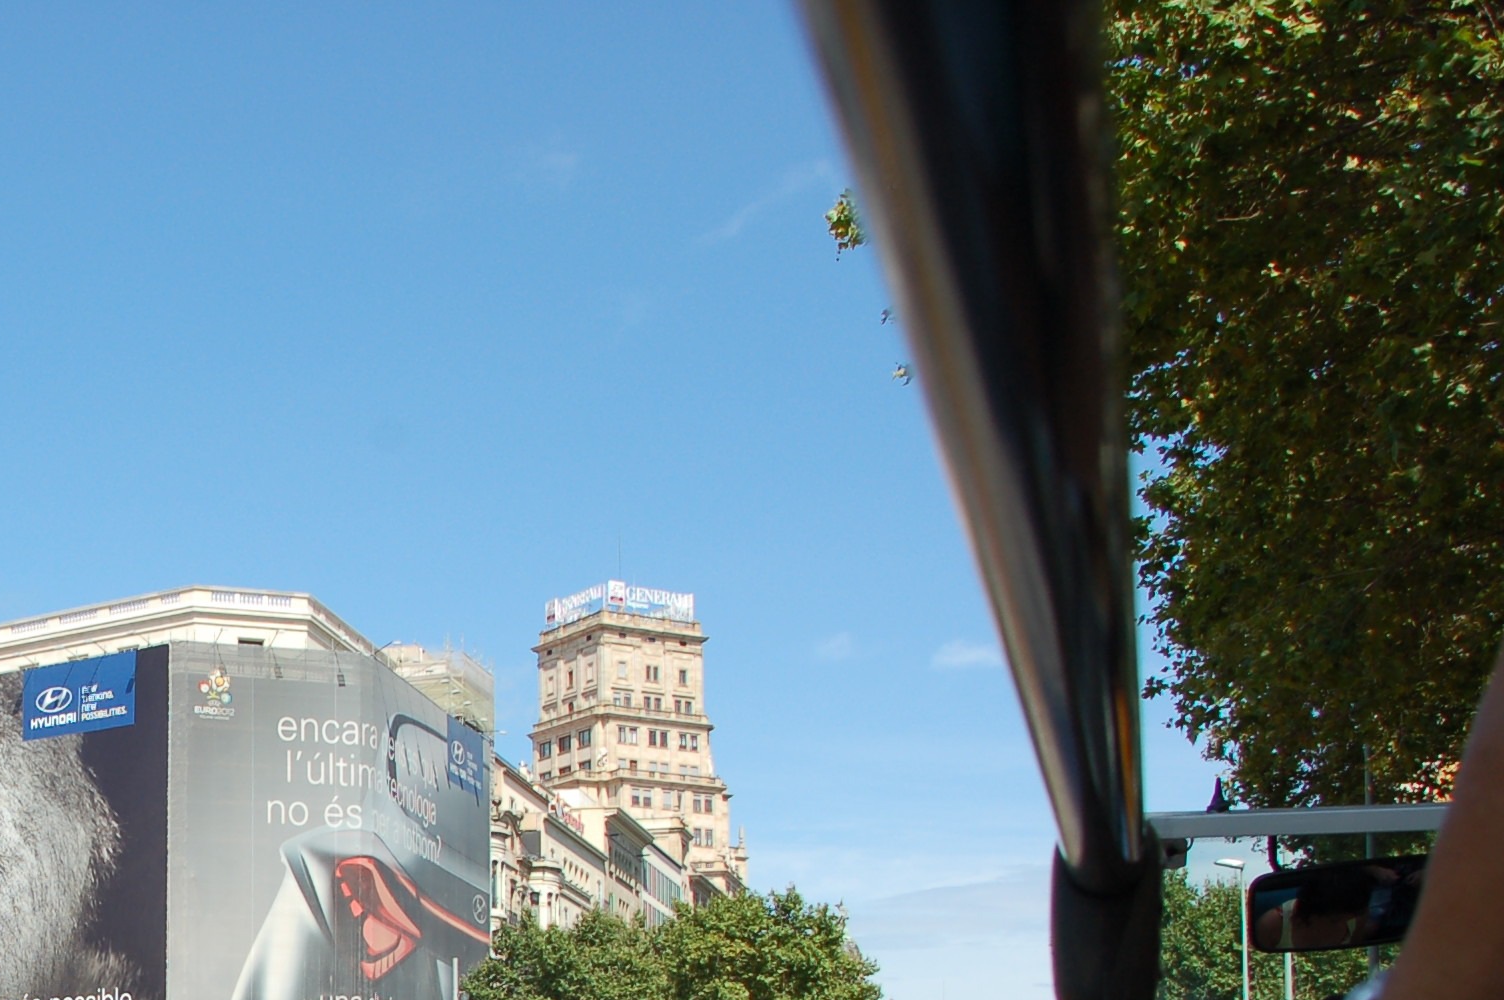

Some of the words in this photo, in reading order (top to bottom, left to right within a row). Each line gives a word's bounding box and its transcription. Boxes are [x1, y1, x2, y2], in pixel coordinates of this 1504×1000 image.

[30, 711, 77, 731] HYUNDAI
[277, 716, 378, 750] encara
[267, 799, 309, 827] no
[323, 795, 363, 830] és
[386, 772, 437, 828] tecnologia
